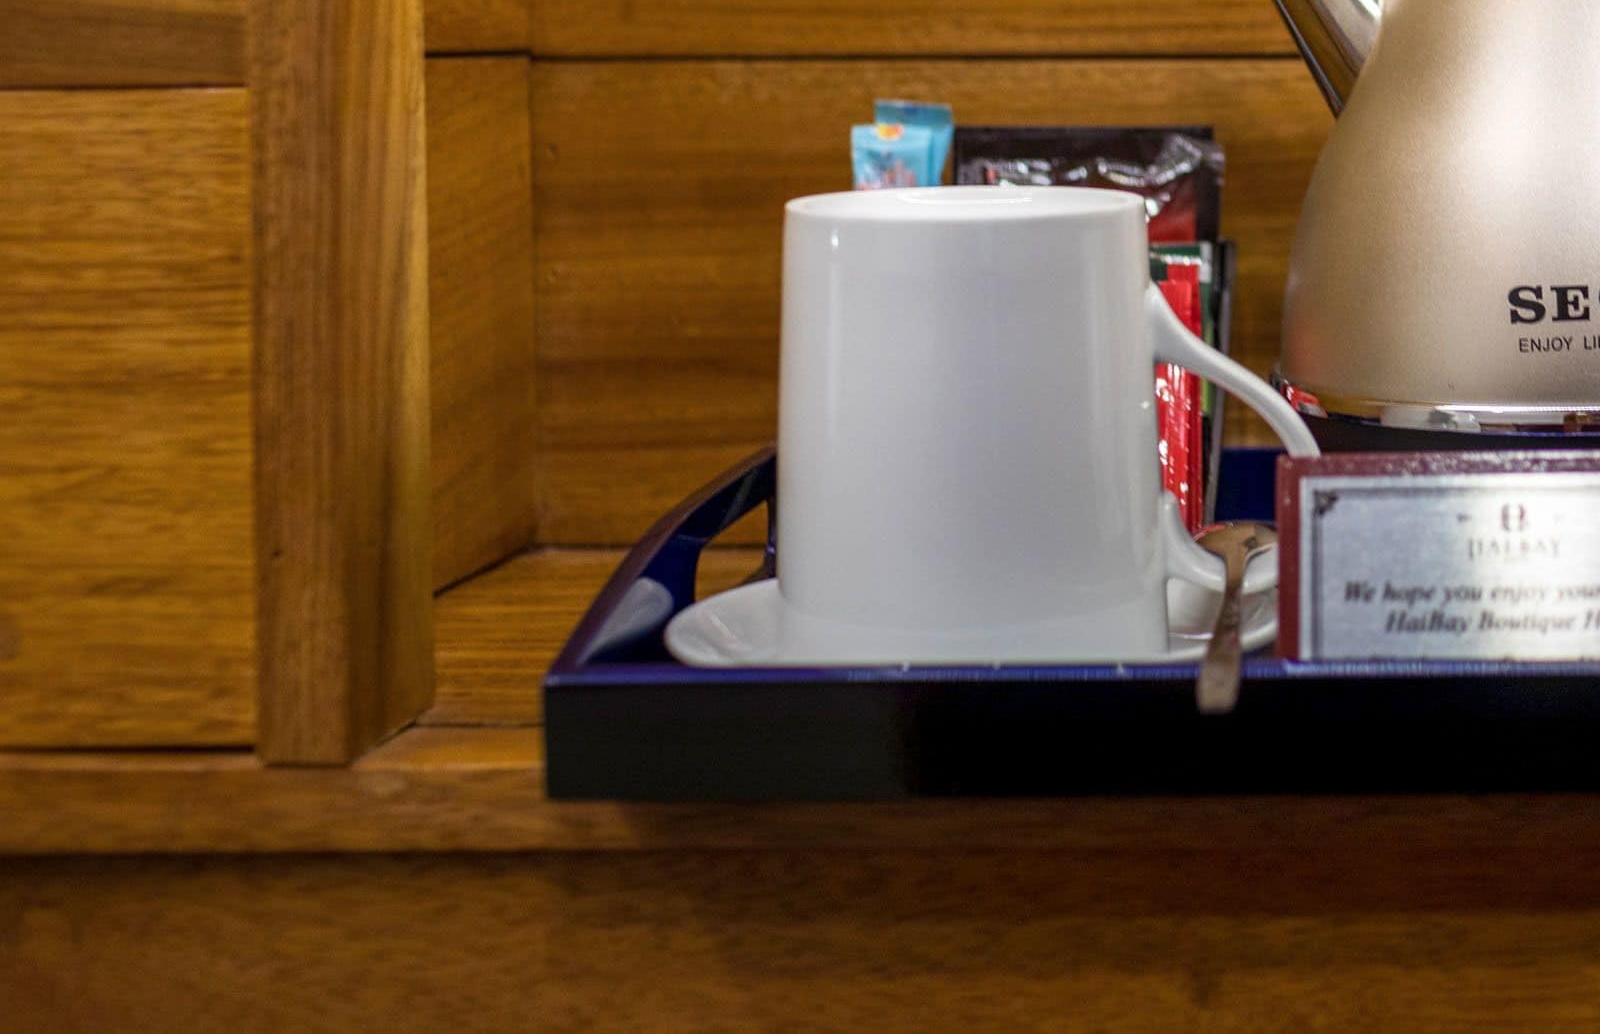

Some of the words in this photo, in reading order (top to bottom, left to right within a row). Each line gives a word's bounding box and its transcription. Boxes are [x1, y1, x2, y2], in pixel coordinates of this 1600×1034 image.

[1518, 336, 1574, 353] ENJOY
[1344, 580, 1375, 602] We
[1382, 580, 1435, 609] hope
[1443, 584, 1483, 610] you
[1490, 584, 1547, 606] enjoy
[1386, 609, 1469, 636] HaiBay
[1478, 609, 1578, 634] Boutique
